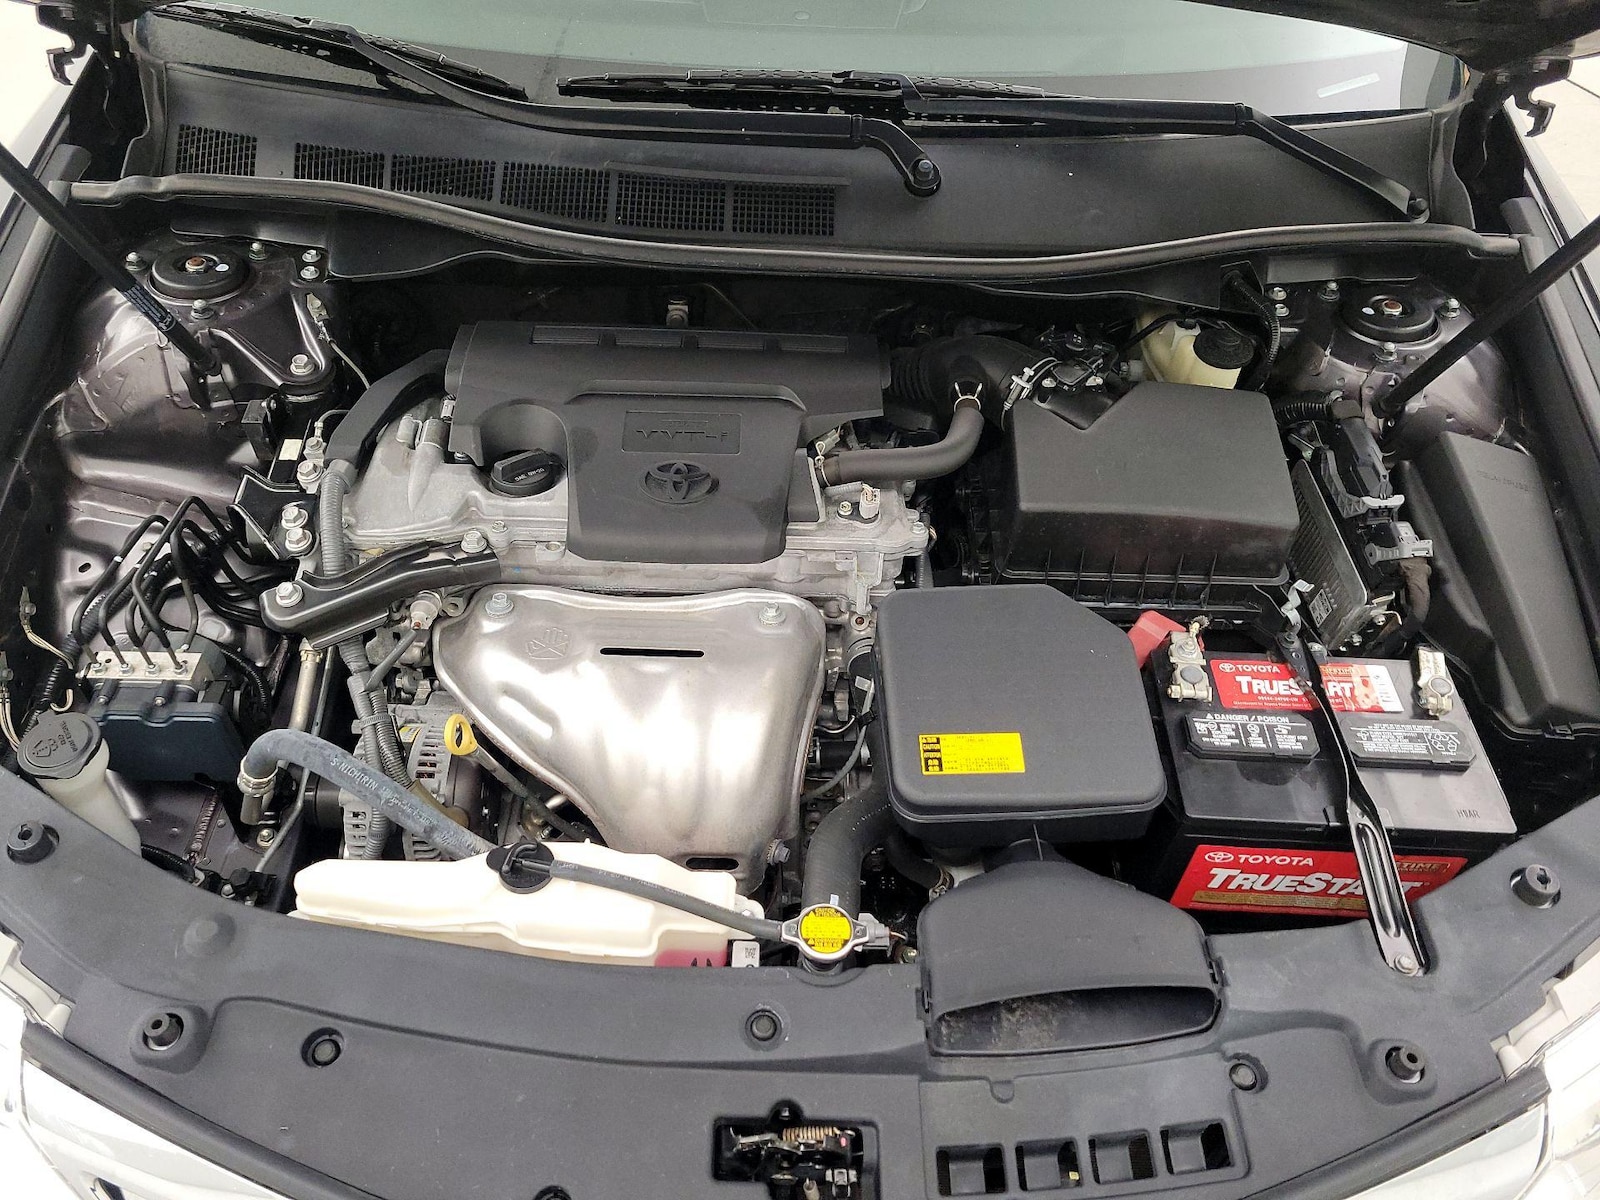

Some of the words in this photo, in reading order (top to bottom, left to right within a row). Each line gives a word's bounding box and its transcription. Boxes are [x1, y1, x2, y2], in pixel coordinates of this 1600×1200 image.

[1236, 664, 1281, 674] TOYOTA
[1214, 713, 1249, 721] DANGER
[1257, 716, 1290, 724] POISON
[1238, 854, 1314, 867] TOYOTA
